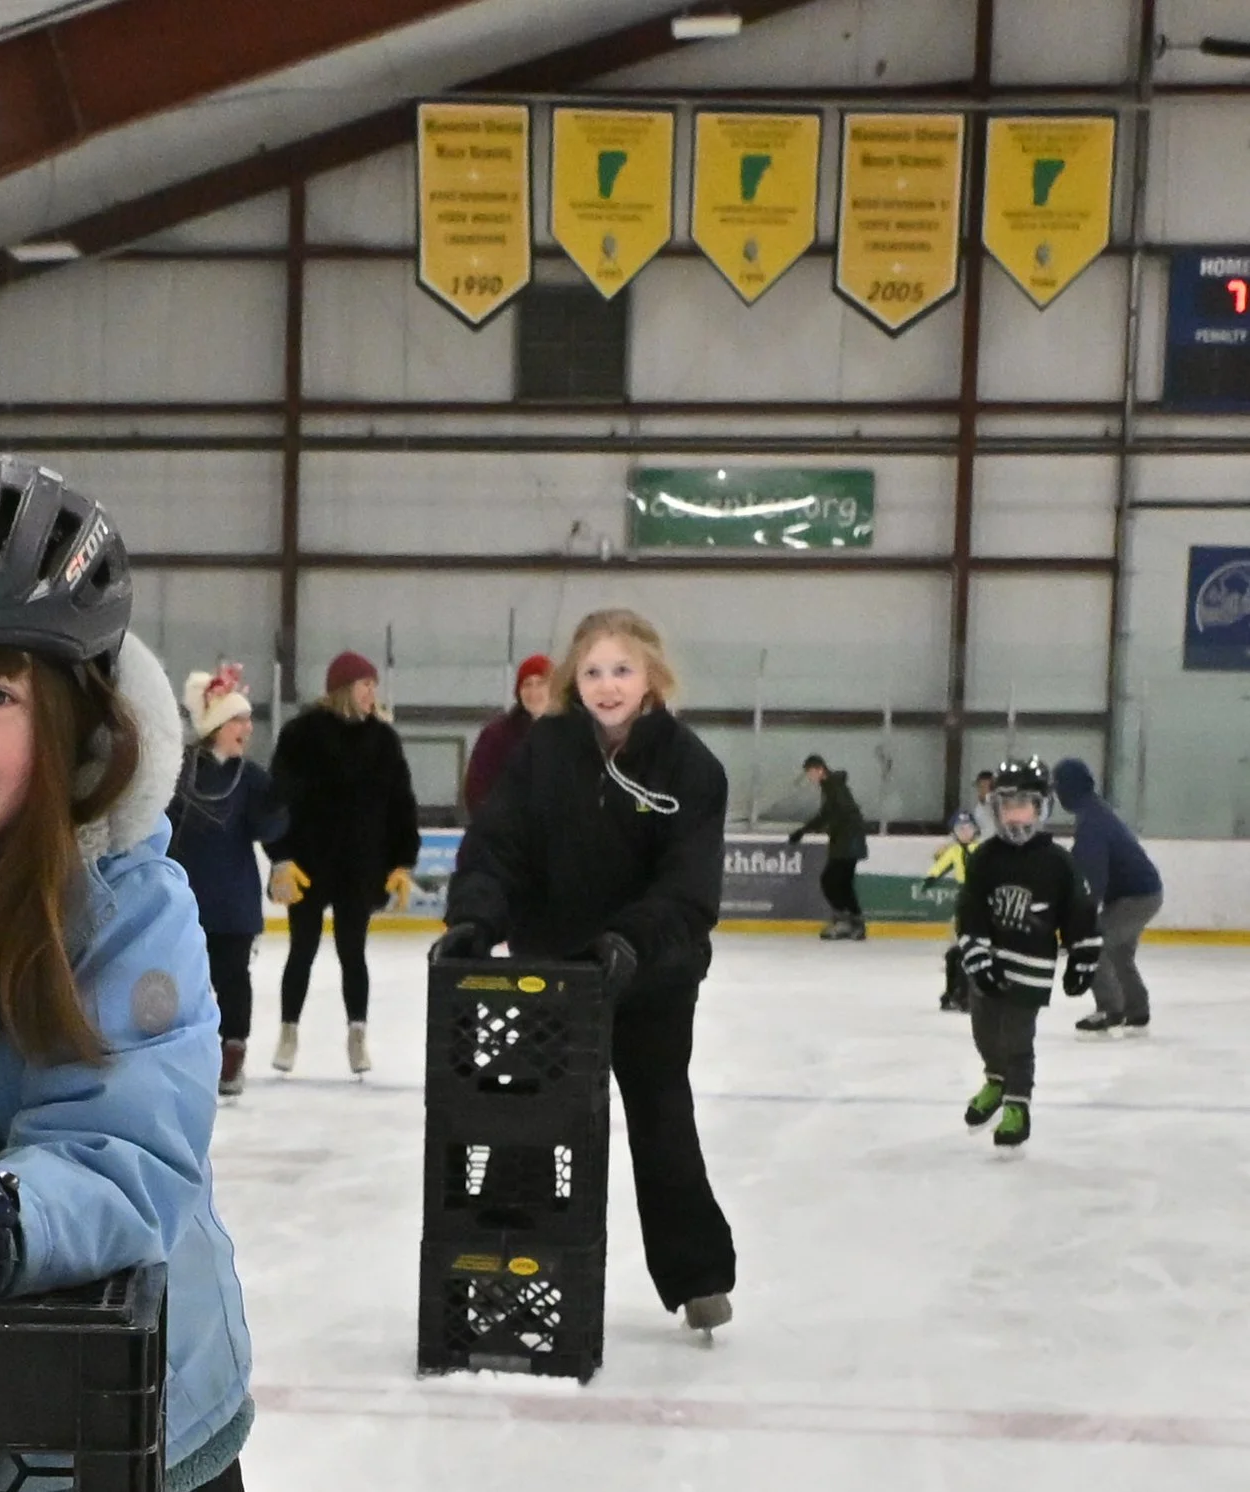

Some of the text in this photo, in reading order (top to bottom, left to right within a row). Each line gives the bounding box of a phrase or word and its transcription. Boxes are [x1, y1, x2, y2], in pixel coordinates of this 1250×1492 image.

[452, 275, 504, 296] 1990
[867, 281, 925, 303] 2005
[65, 515, 109, 591] SCOTT
[724, 849, 803, 874] thfield
